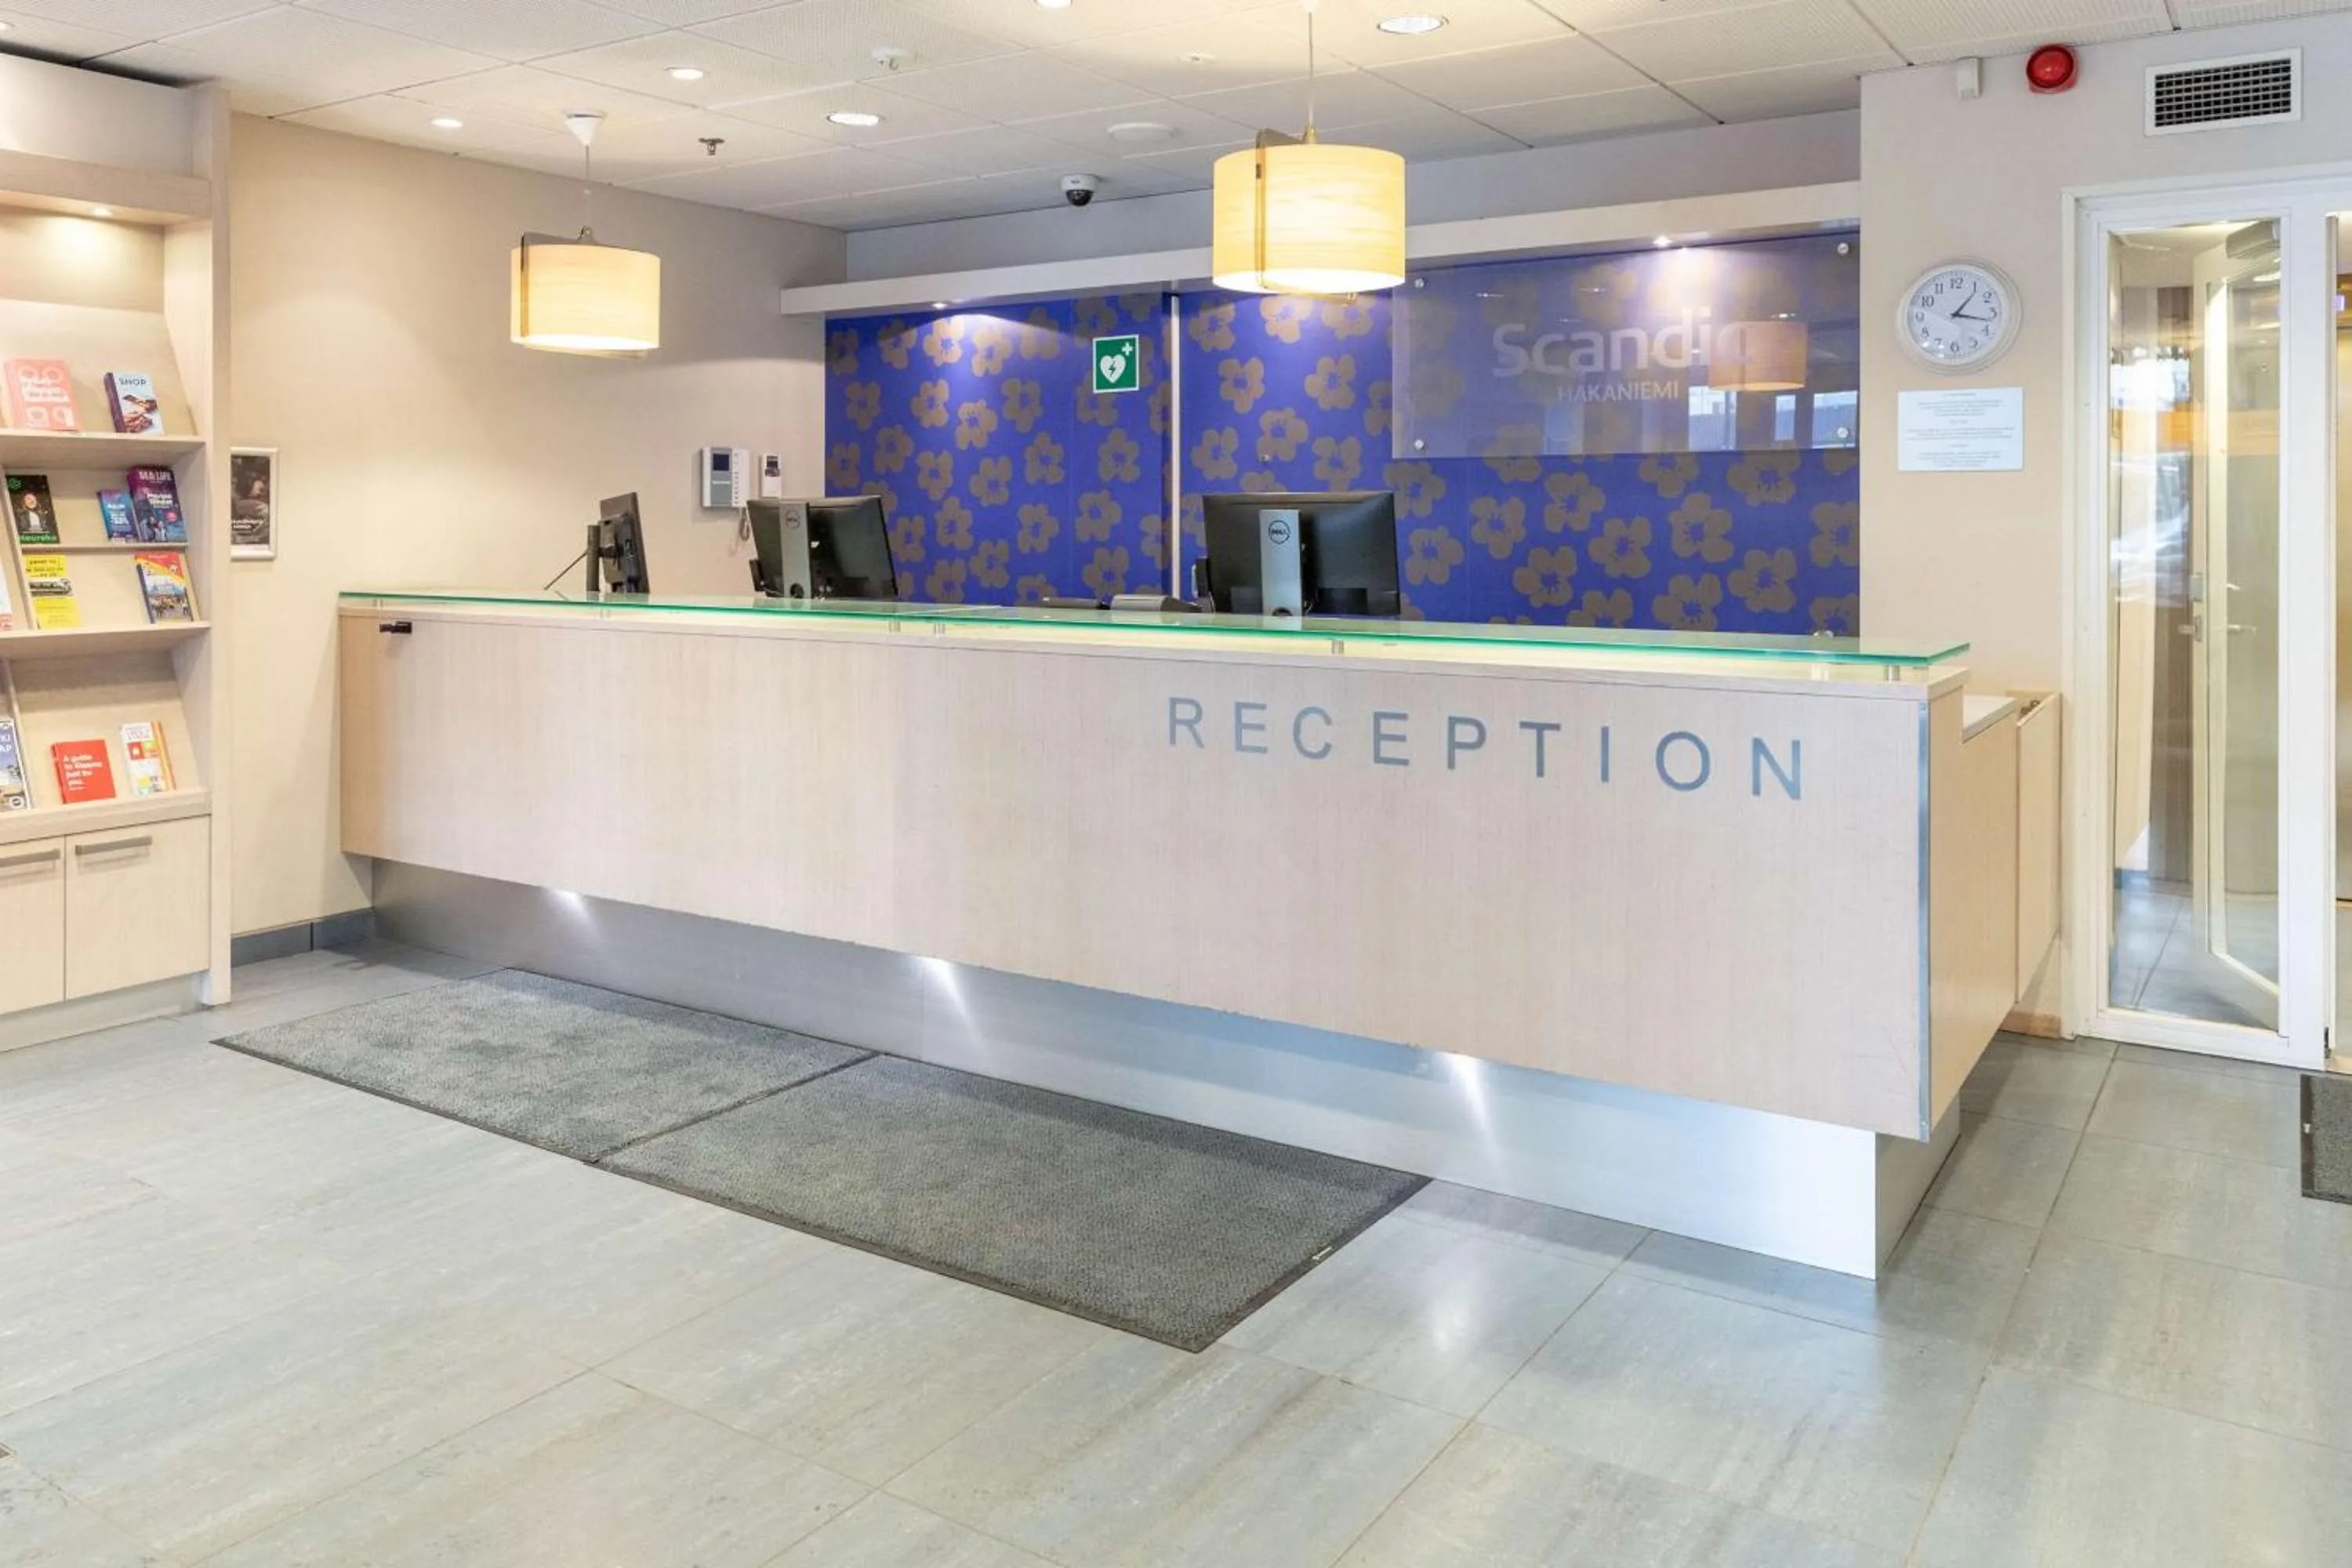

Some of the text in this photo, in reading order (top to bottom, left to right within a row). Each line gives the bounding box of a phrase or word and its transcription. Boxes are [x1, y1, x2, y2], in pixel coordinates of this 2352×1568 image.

[1934, 282, 1944, 295] 11
[1949, 277, 1964, 289] 12
[1921, 295, 1934, 308] 10
[1983, 290, 1993, 303] 2
[1981, 323, 1990, 336] 4
[1949, 340, 1960, 353] 6
[1557, 379, 1679, 404] HAKANIEMI
[1167, 695, 1802, 800] RECEPTION
